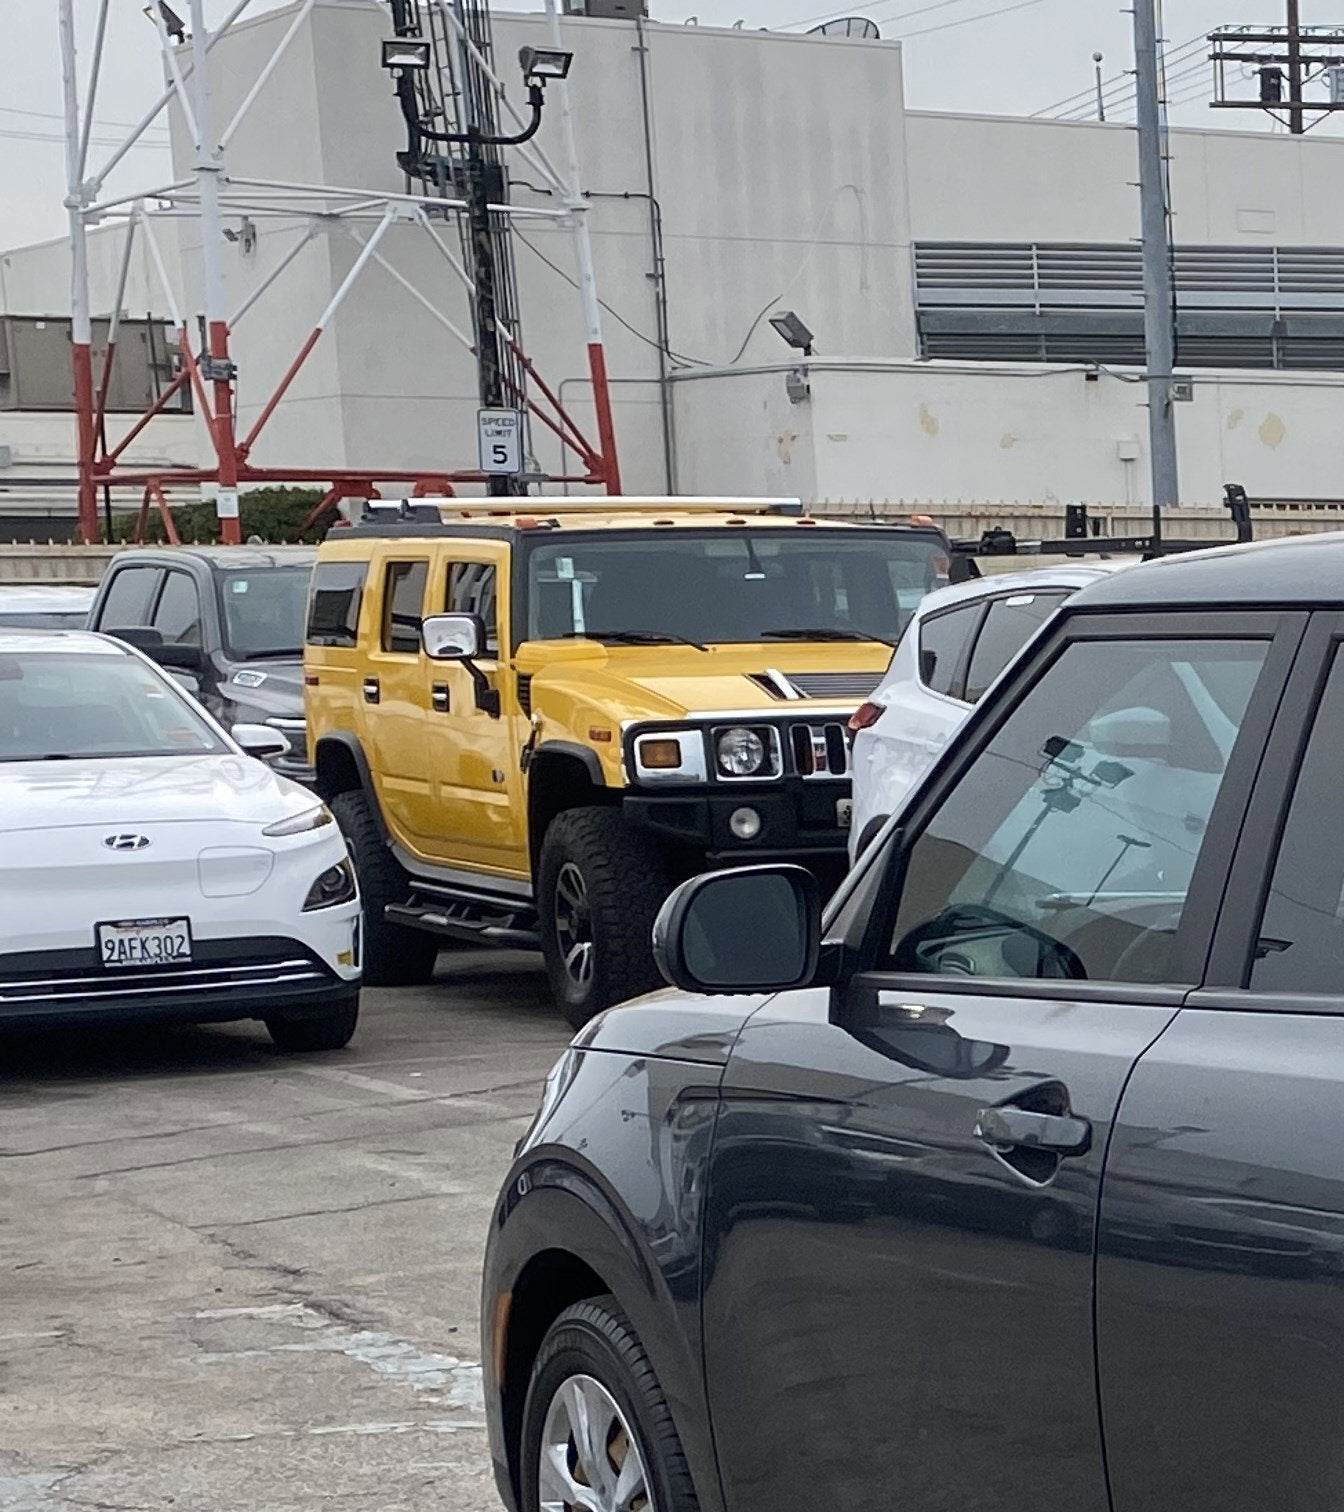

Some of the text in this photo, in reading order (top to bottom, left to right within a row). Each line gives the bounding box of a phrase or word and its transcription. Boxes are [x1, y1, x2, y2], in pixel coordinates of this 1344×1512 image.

[481, 417, 517, 427] SPEED
[484, 429, 512, 438] LIMIT
[492, 444, 508, 464] 5
[104, 934, 186, 961] 9AFK302
